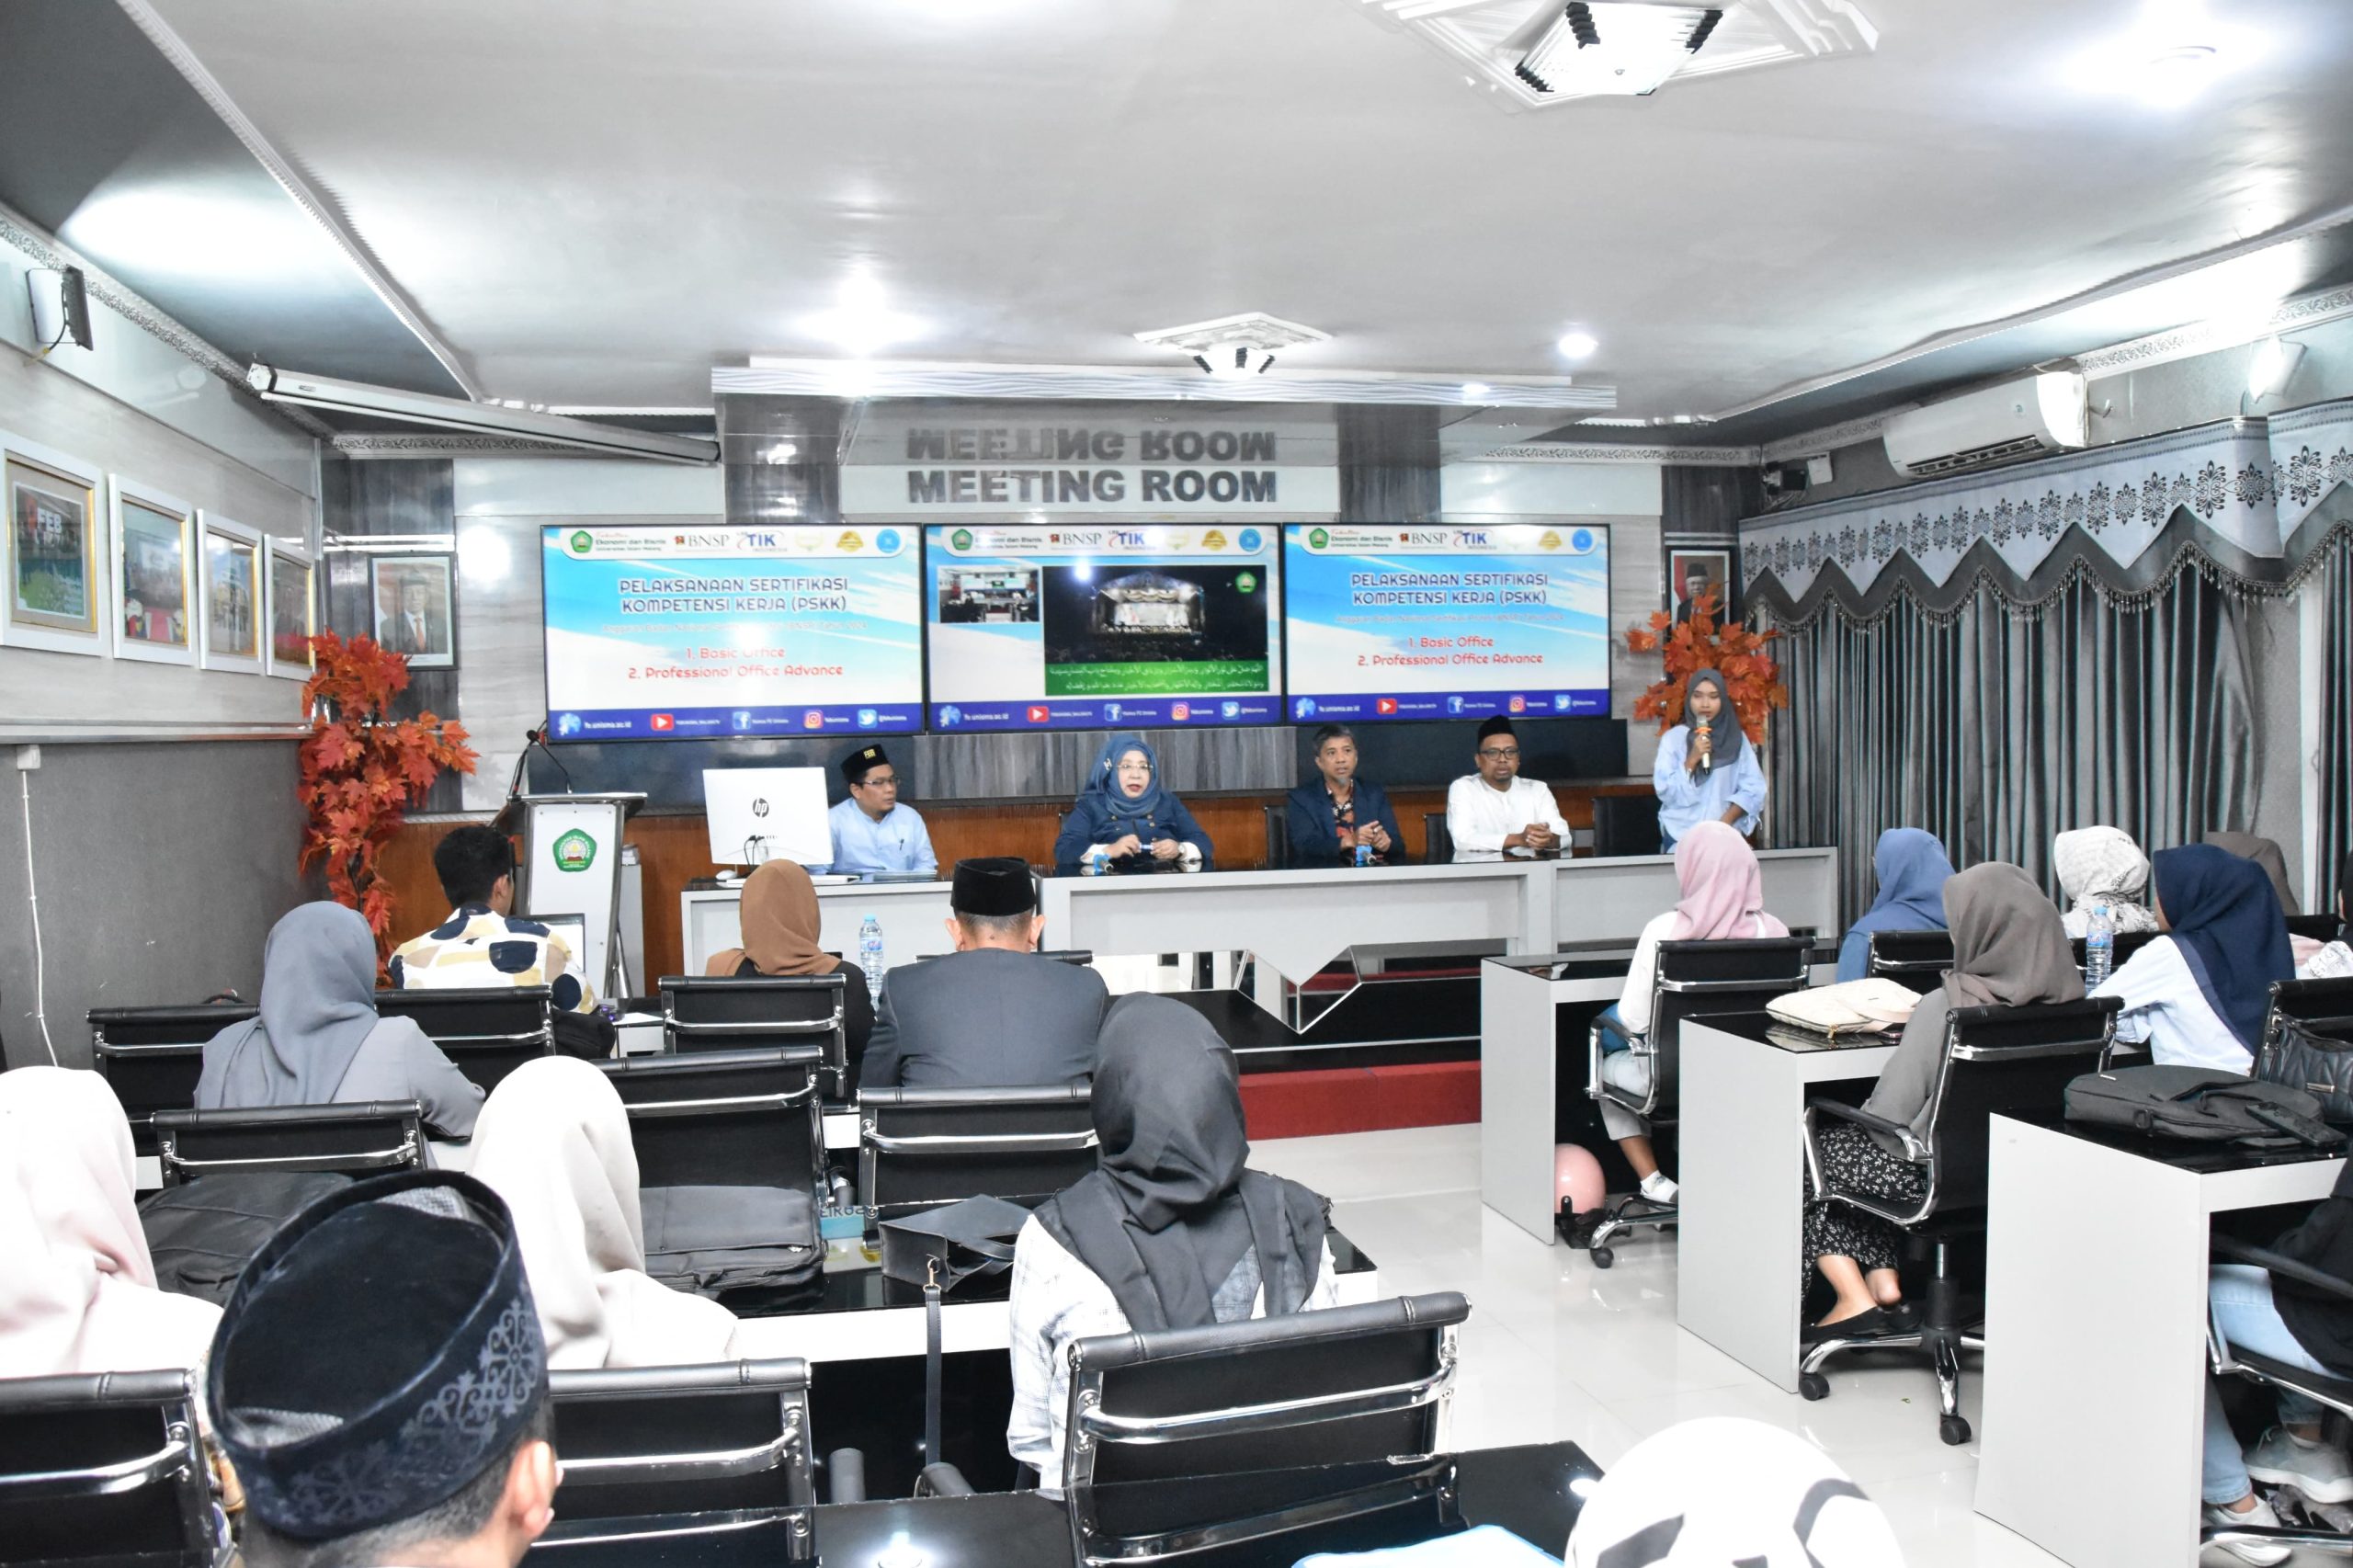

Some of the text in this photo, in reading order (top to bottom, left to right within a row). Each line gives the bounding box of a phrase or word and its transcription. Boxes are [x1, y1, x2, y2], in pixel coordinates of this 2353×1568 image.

[908, 470, 1277, 503] MEETING ROOM
[688, 534, 730, 547] BNSP
[747, 533, 776, 546] TIK
[1063, 532, 1102, 545] BNSP
[1118, 532, 1144, 545] TIK
[1412, 532, 1448, 545] BNSP
[1462, 532, 1486, 545] TIK
[620, 577, 847, 593] PELAKSANAAN SERTIFIKASI
[1351, 574, 1549, 586] PELAKSANAAN SERTIFIKASI
[622, 595, 847, 612] KOMPETENSI KERJA (PSKK)
[1353, 590, 1548, 605] KOMPETENSI KERJA (PSKK)
[1408, 636, 1495, 648] 1. Basic Office
[687, 648, 696, 660] 1.
[700, 647, 737, 659] Basic
[1358, 653, 1544, 666] 2. Professional Office Advance
[628, 665, 844, 679] 2. Professional Office Advance
[754, 798, 769, 818] hp
